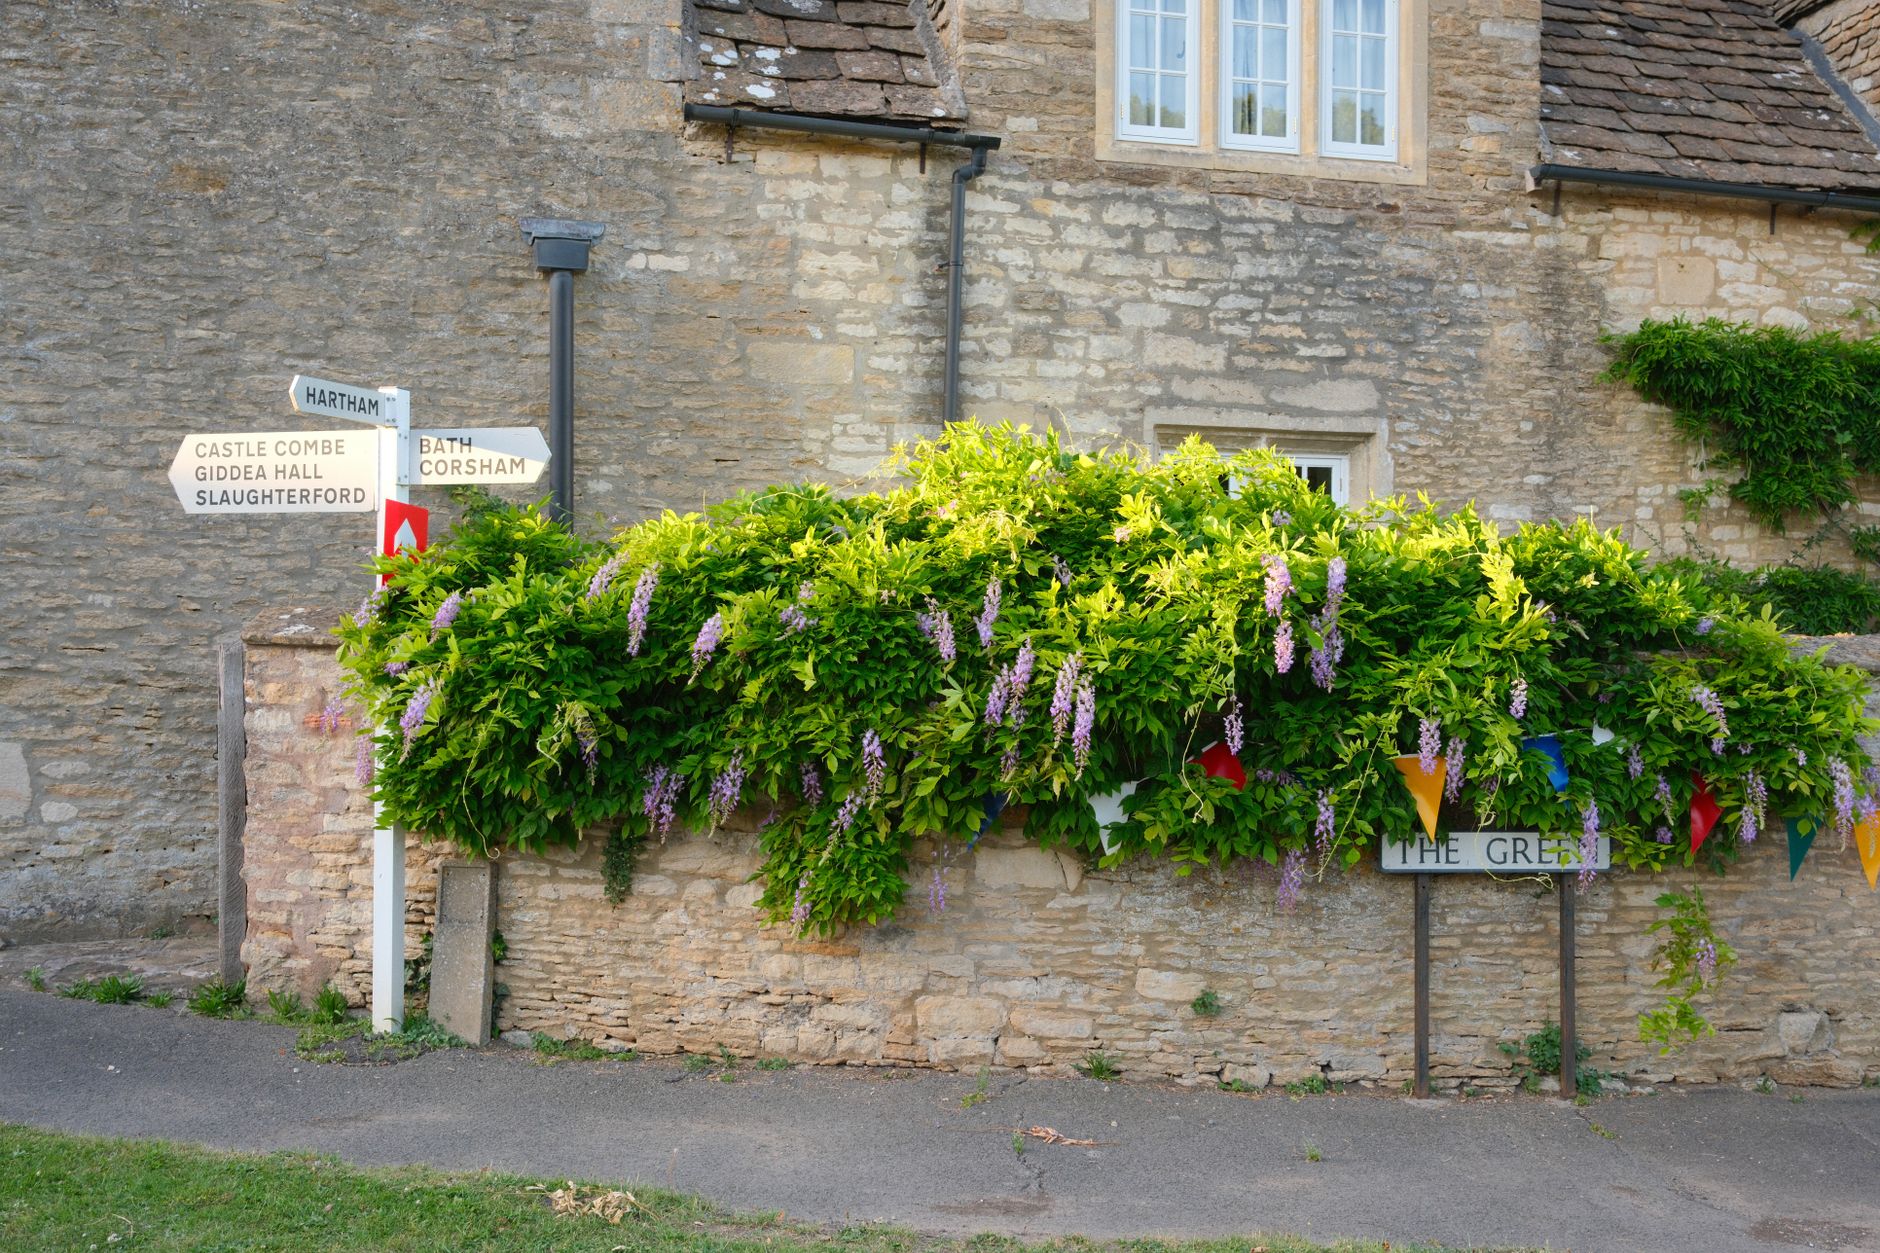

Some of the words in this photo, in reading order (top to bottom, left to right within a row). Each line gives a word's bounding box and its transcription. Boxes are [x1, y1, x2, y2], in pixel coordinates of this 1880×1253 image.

[305, 387, 379, 416] HARTHAM
[194, 441, 267, 458] CASTLE
[274, 439, 346, 457] COMBE
[419, 436, 472, 454] BATH
[194, 465, 267, 482] GIDDEA
[274, 462, 323, 481] HALL
[419, 457, 526, 476] CORSHAM
[194, 487, 366, 507] SLAUGHTERFORD
[1398, 837, 1461, 865] THE
